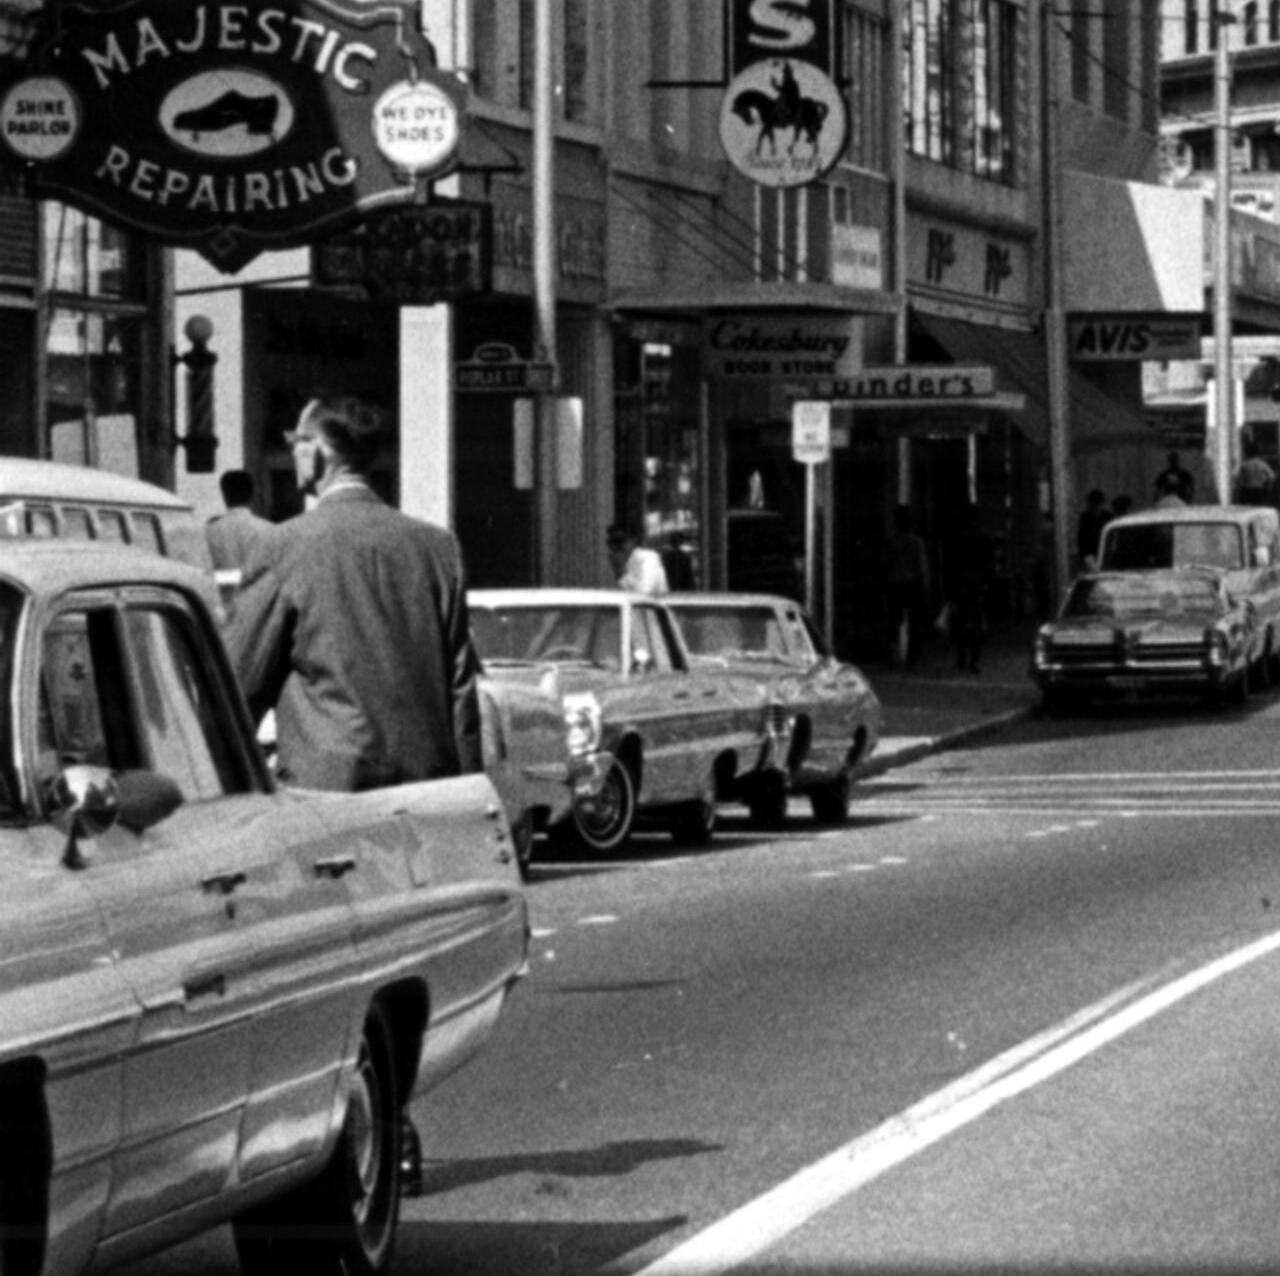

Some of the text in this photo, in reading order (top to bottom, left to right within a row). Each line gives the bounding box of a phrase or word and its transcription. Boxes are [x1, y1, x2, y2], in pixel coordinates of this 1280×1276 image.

[80, 5, 379, 93] MAJESTIC
[15, 99, 66, 116] SHINE
[382, 106, 449, 122] WE DYE
[7, 119, 71, 135] PARLOR
[385, 125, 445, 142] SHOES
[96, 145, 359, 211] REPAIRING
[711, 319, 850, 359] Cokesbury
[1075, 324, 1151, 353] AVIS
[724, 359, 836, 375] BOOK STORE
